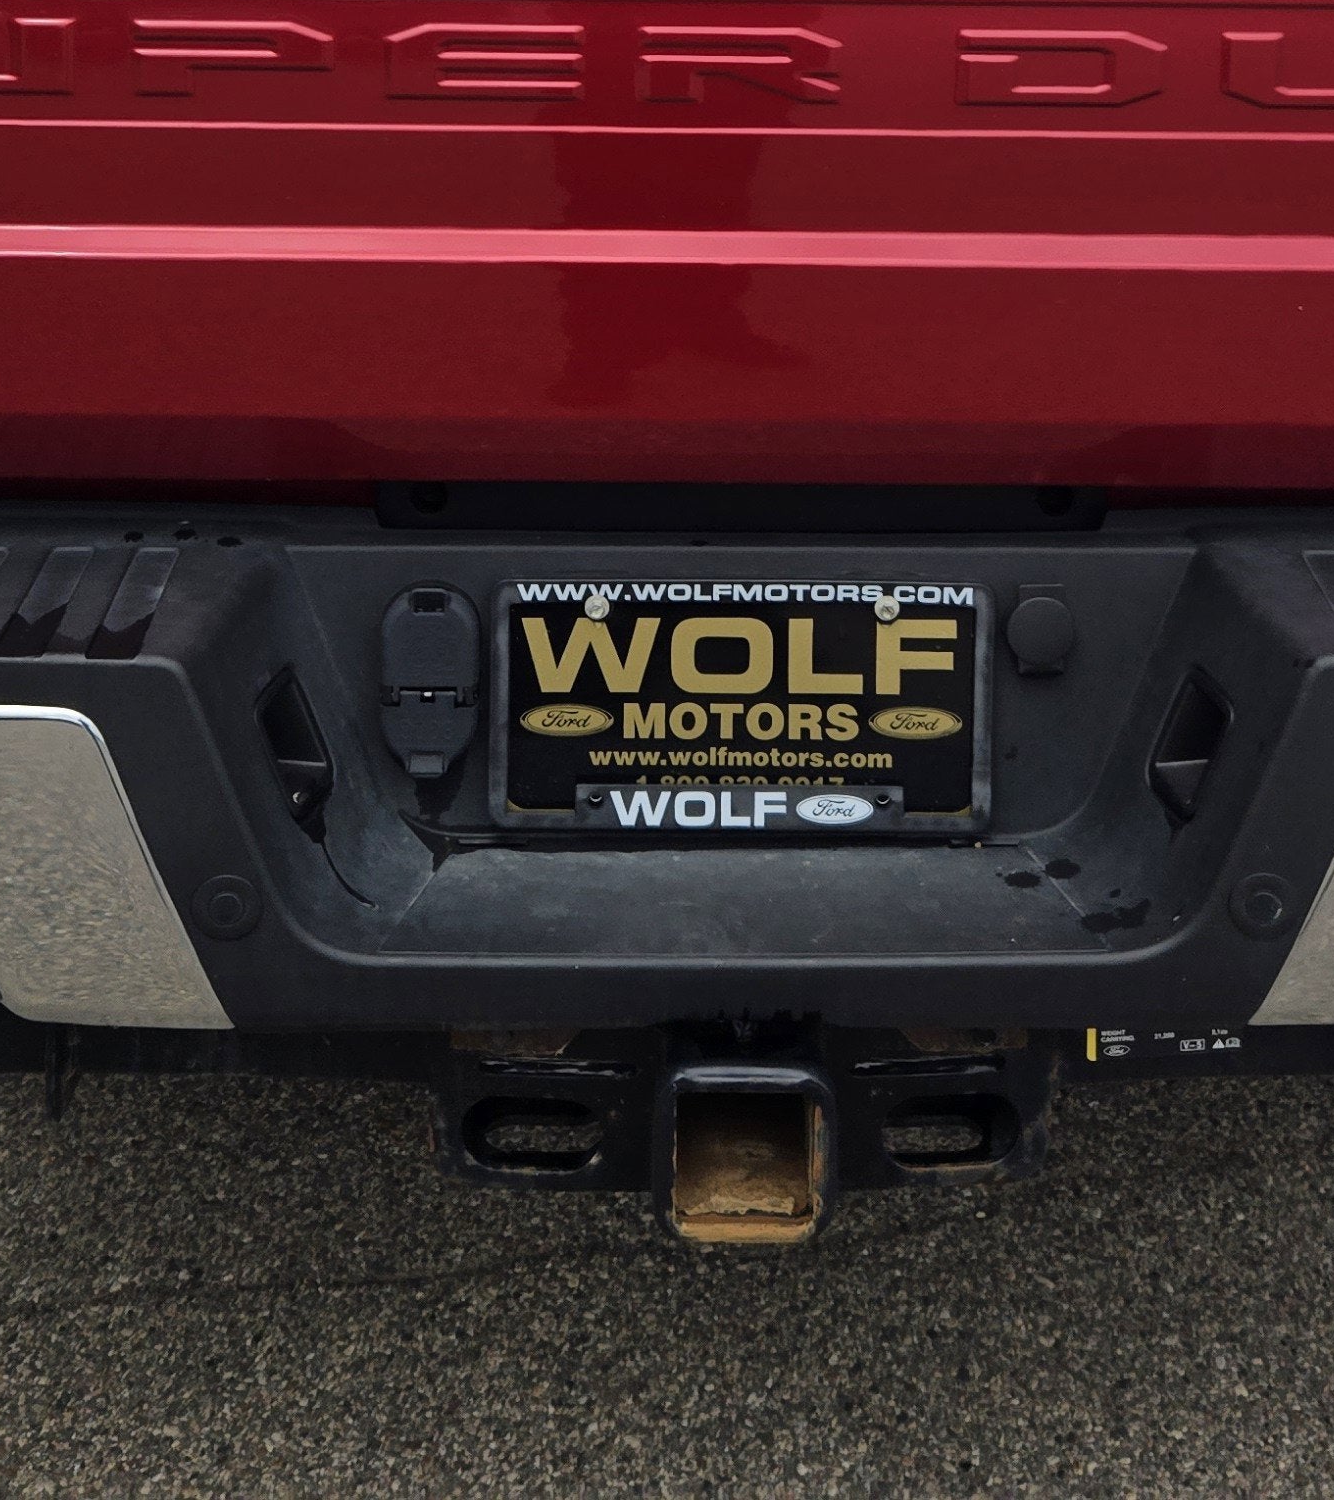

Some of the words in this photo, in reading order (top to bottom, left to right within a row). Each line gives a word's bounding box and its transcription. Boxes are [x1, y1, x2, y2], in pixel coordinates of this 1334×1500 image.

[517, 583, 974, 606] WWW.WOLFMOTORSCOM
[521, 616, 958, 696] WOLF
[541, 709, 592, 729] Ford
[623, 702, 860, 742] MOTORS
[889, 711, 940, 732] Ford
[589, 746, 893, 769] www.wolfmotors.com
[610, 789, 788, 828] WOLF
[812, 798, 857, 818] Ford
